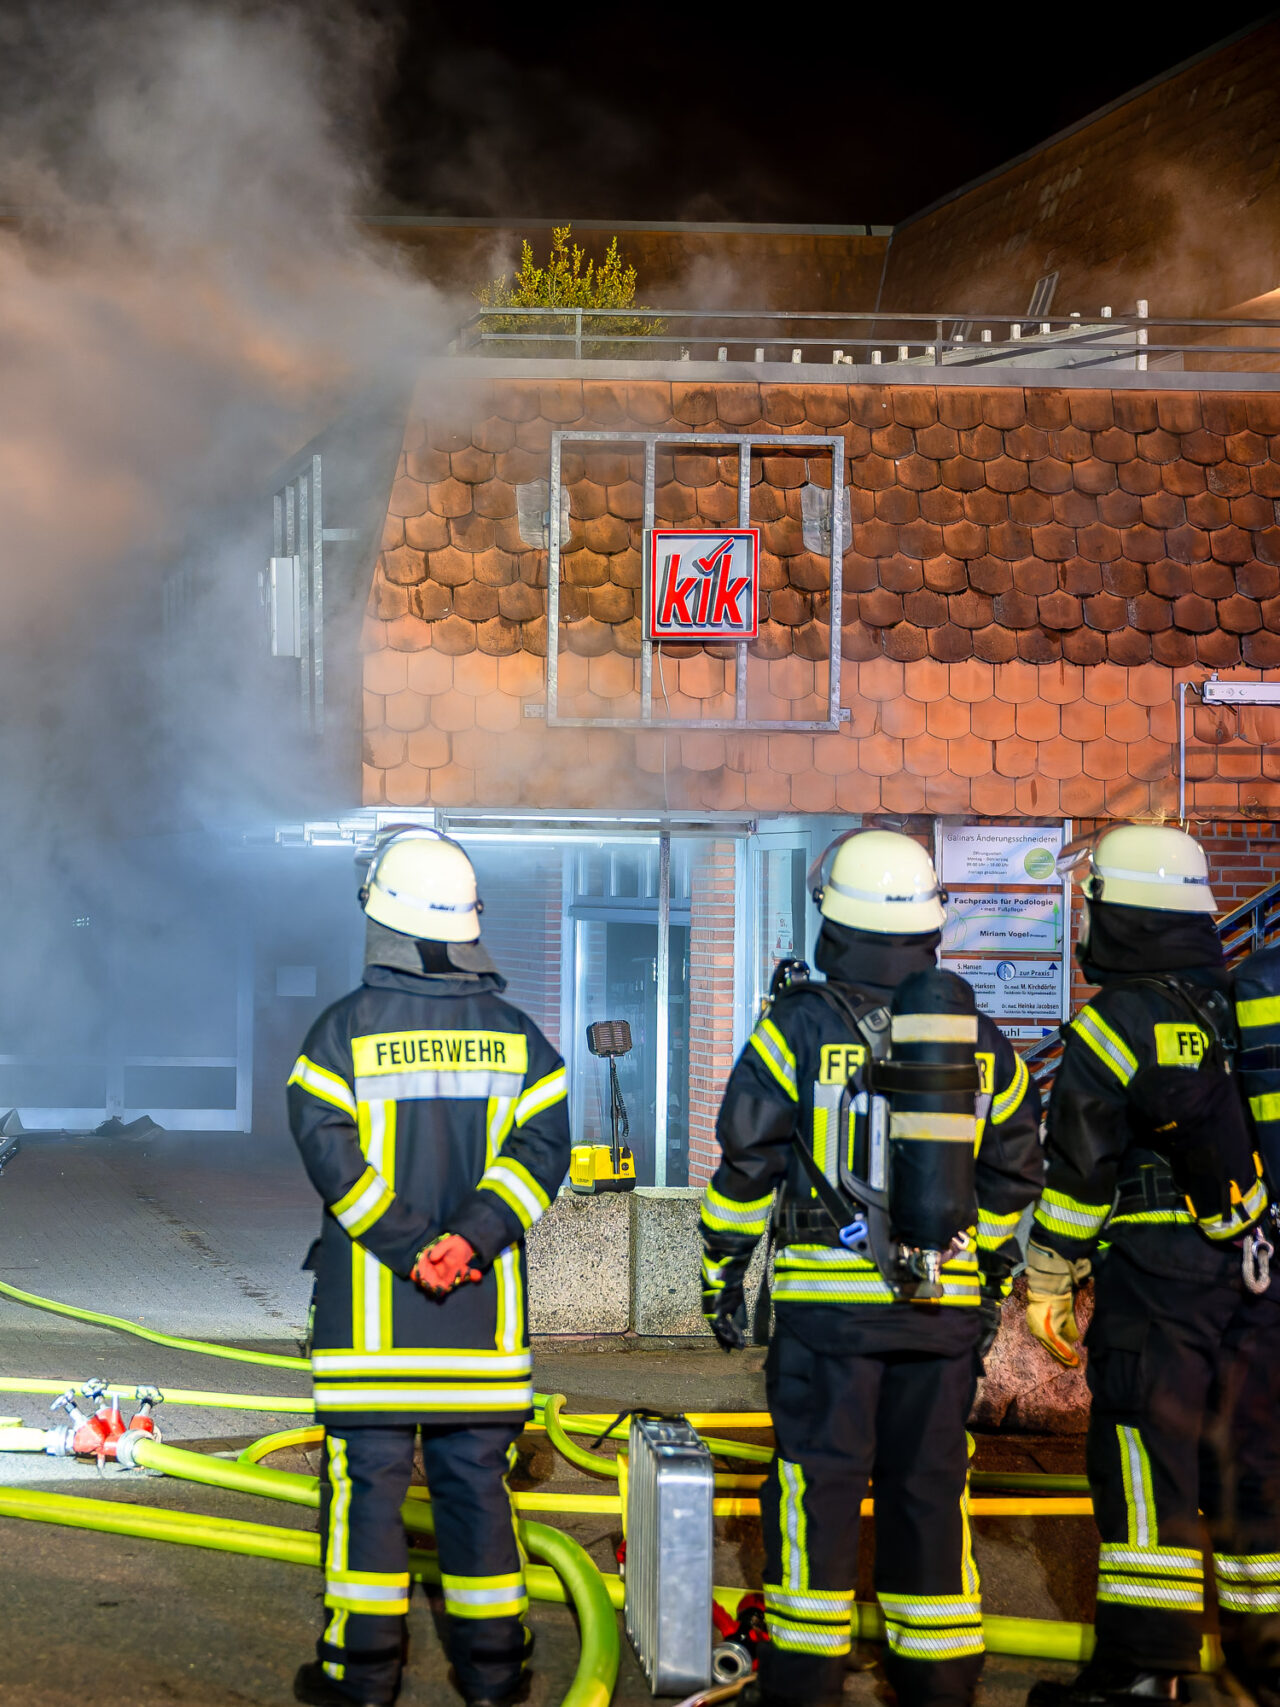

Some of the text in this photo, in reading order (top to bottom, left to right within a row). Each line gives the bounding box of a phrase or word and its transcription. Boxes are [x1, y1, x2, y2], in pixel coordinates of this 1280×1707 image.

[976, 833, 1058, 844] Änderungsschneiderei
[954, 897, 998, 906] Fachpraxis
[1014, 898, 1053, 907] Podologie
[376, 1039, 507, 1066] FEUERWEHR
